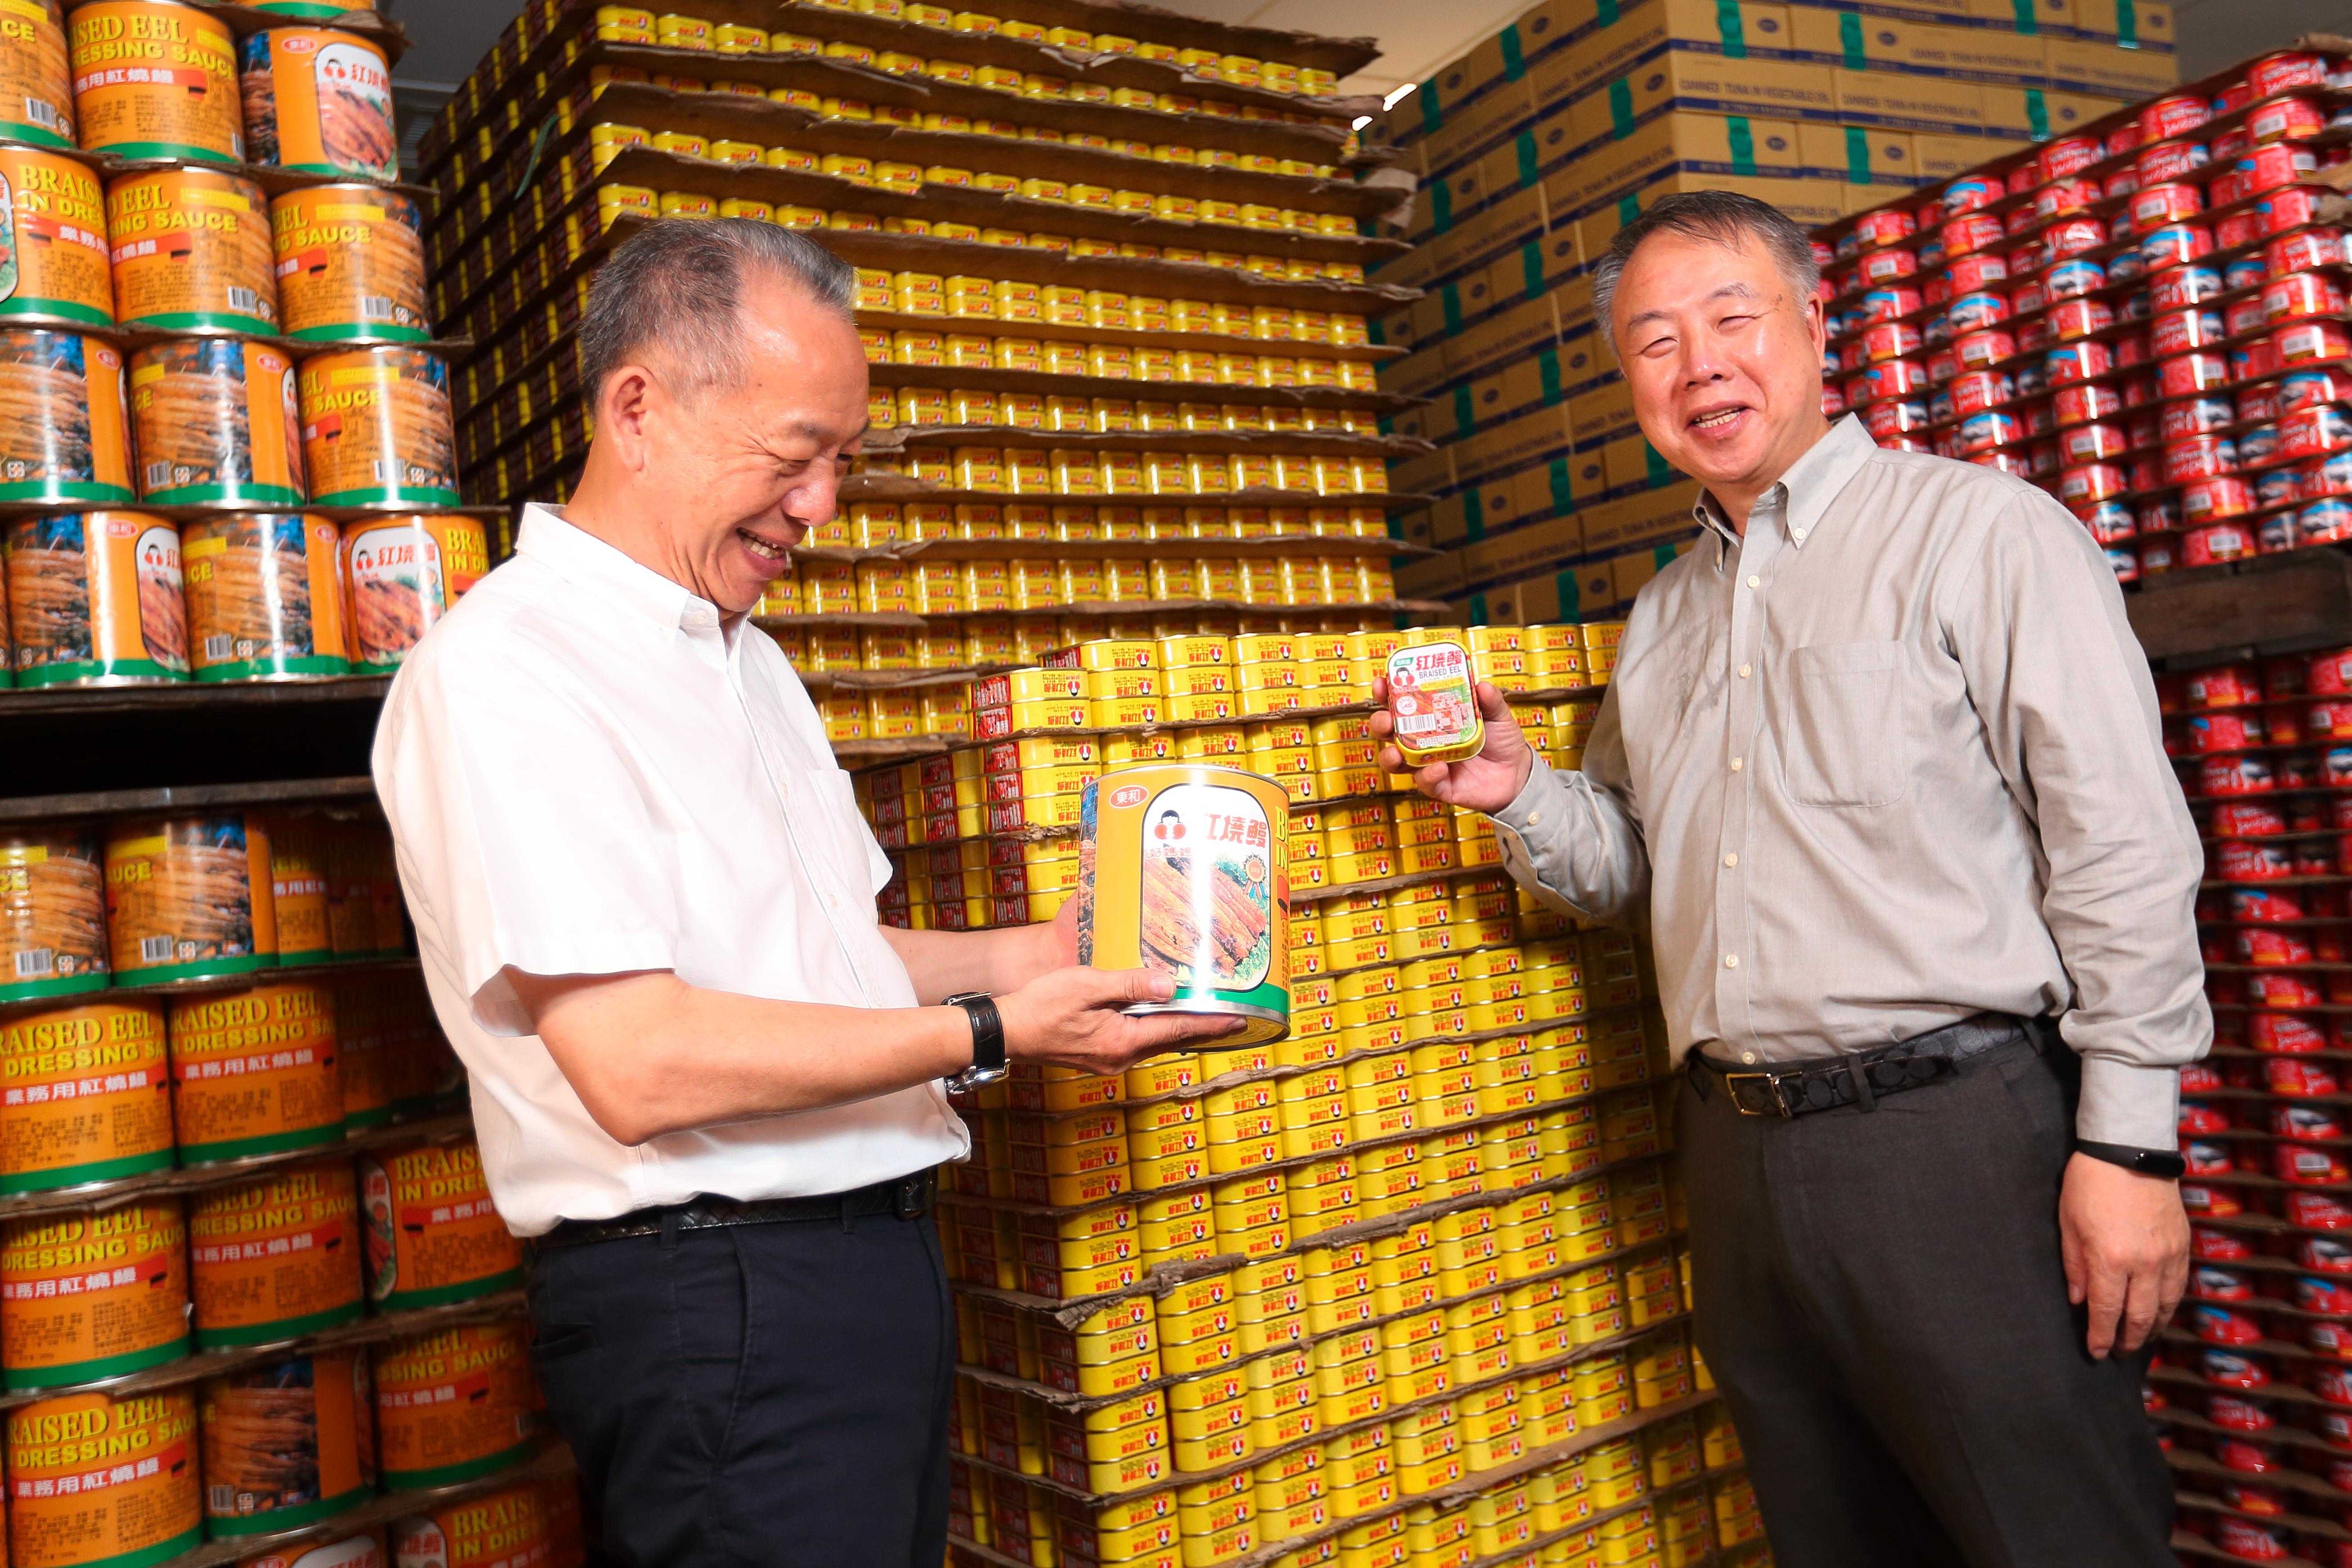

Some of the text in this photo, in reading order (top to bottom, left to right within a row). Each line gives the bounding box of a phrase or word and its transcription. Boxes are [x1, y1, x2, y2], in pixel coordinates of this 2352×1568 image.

[129, 15, 190, 45] EEL
[122, 183, 172, 215] EEL
[154, 211, 239, 232] SAUCE
[294, 226, 372, 247] SAUCE
[1415, 650, 1462, 671] 紅燒鰻
[1419, 667, 1447, 679] BRAISED
[1449, 665, 1462, 674] EEL
[1116, 789, 1141, 805] 東和
[1146, 847, 1193, 858] 好媽媽
[274, 991, 322, 1020] EEL
[108, 1011, 155, 1042] EEL
[183, 1020, 307, 1053] DRESSING
[5, 1042, 139, 1078] DRESSING
[272, 1173, 326, 1205] EEL
[398, 1182, 422, 1202] IN
[93, 1208, 152, 1237] EEL
[2, 1238, 127, 1270] DRESSING
[115, 1394, 172, 1430] EEL
[18, 1428, 151, 1468] DRESSING
